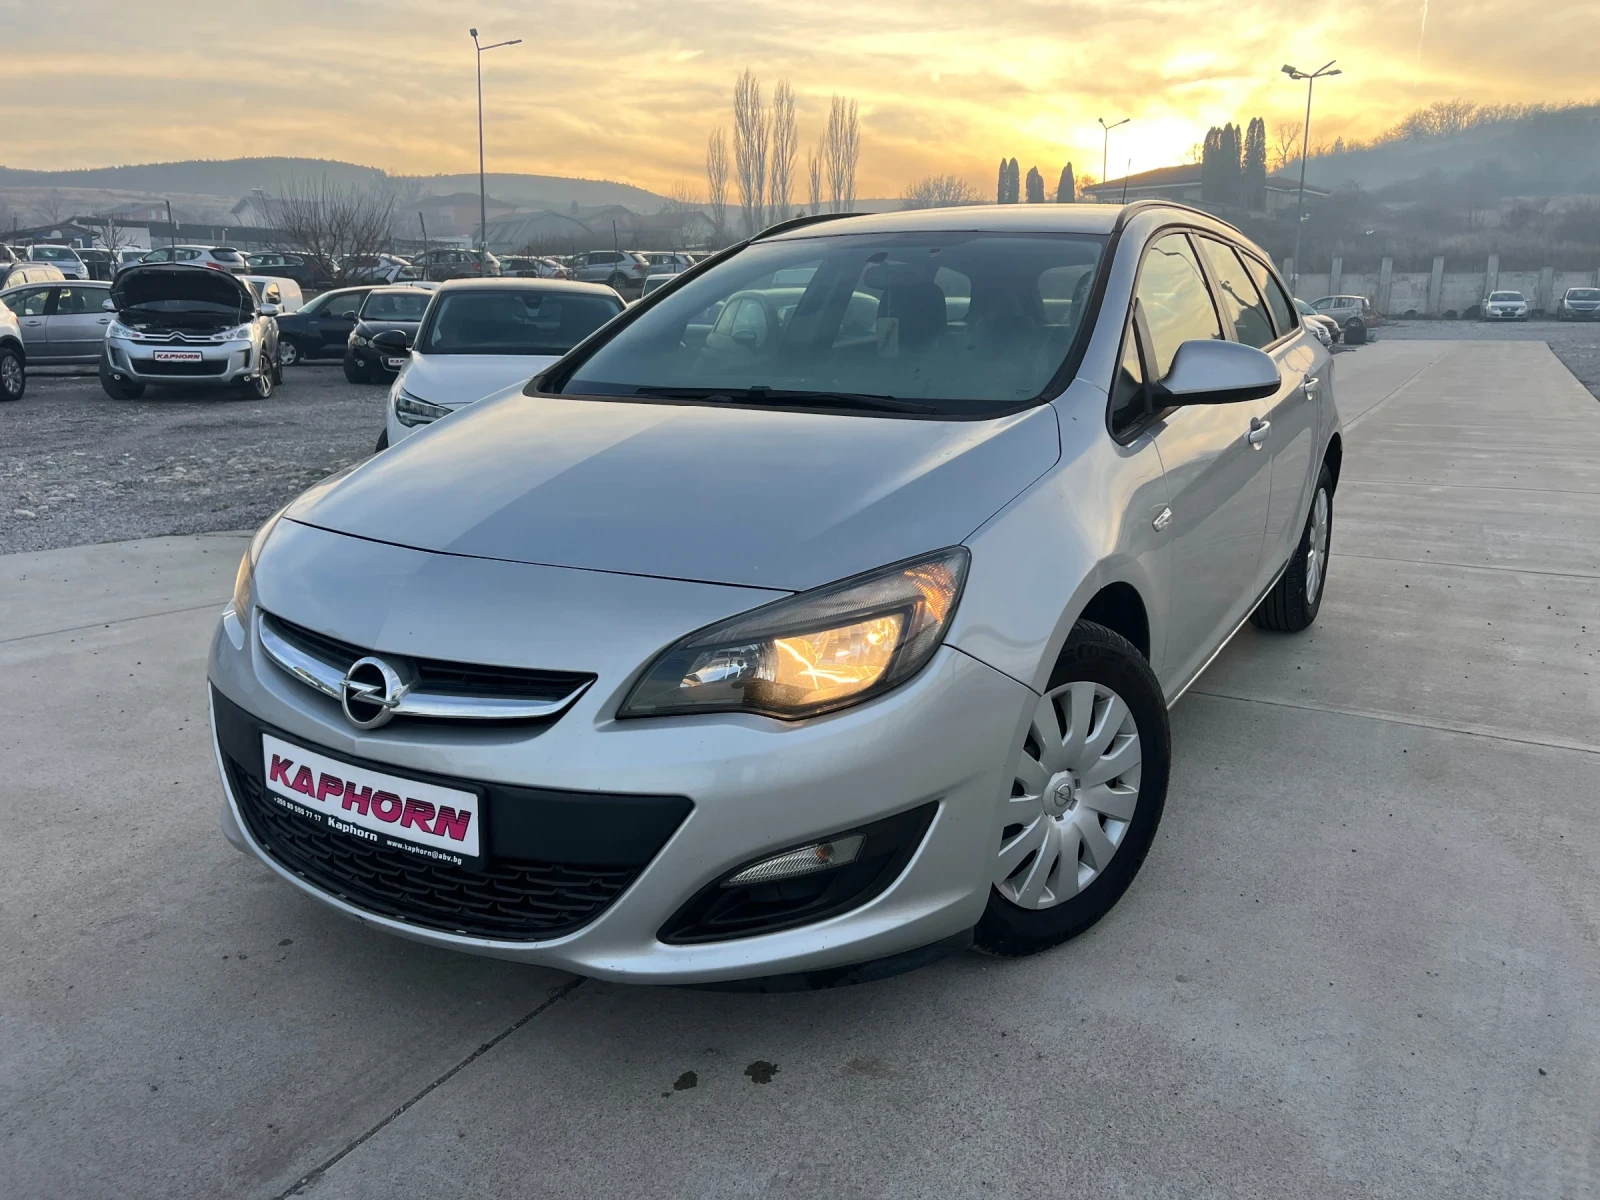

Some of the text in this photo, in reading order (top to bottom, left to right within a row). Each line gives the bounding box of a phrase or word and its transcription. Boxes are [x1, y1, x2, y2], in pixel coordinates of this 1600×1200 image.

[269, 753, 472, 842] KAPHORN
[314, 814, 322, 822] 17
[327, 816, 378, 842] Kaphorn
